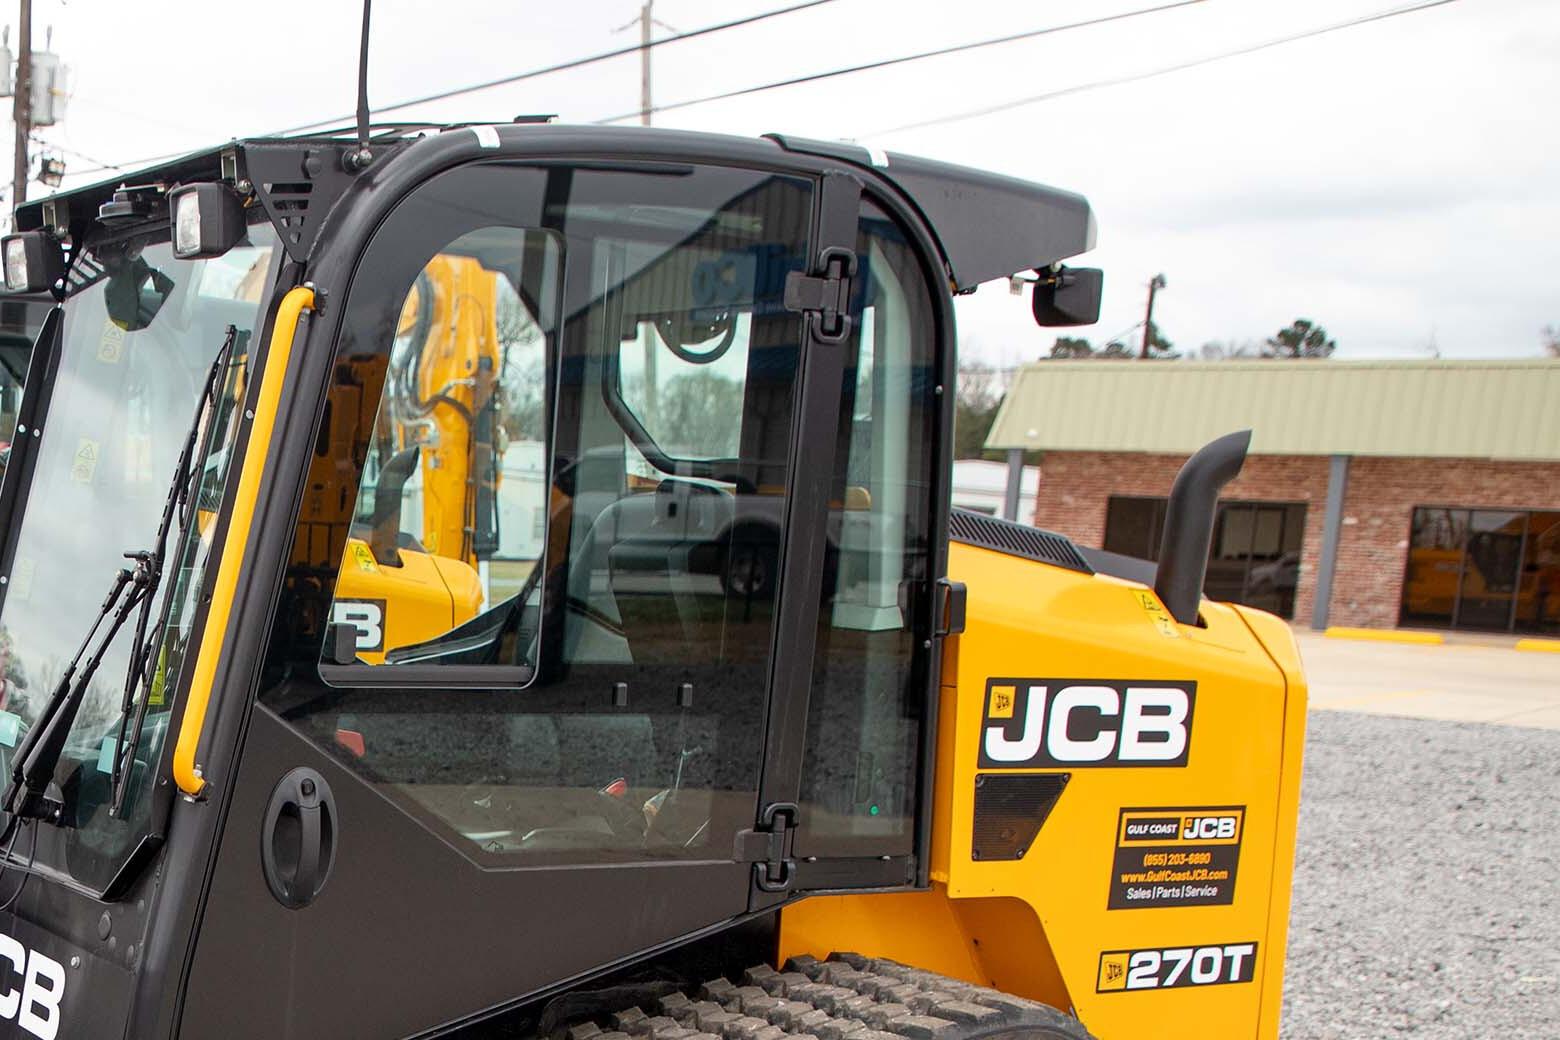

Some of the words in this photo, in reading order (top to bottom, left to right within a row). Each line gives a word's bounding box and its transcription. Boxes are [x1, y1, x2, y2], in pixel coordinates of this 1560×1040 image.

[985, 686, 1189, 762] JCB
[1127, 824, 1149, 835] GULF
[1149, 823, 1178, 834] COAST
[1183, 817, 1236, 839] JCB
[1126, 944, 1254, 990] 270T
